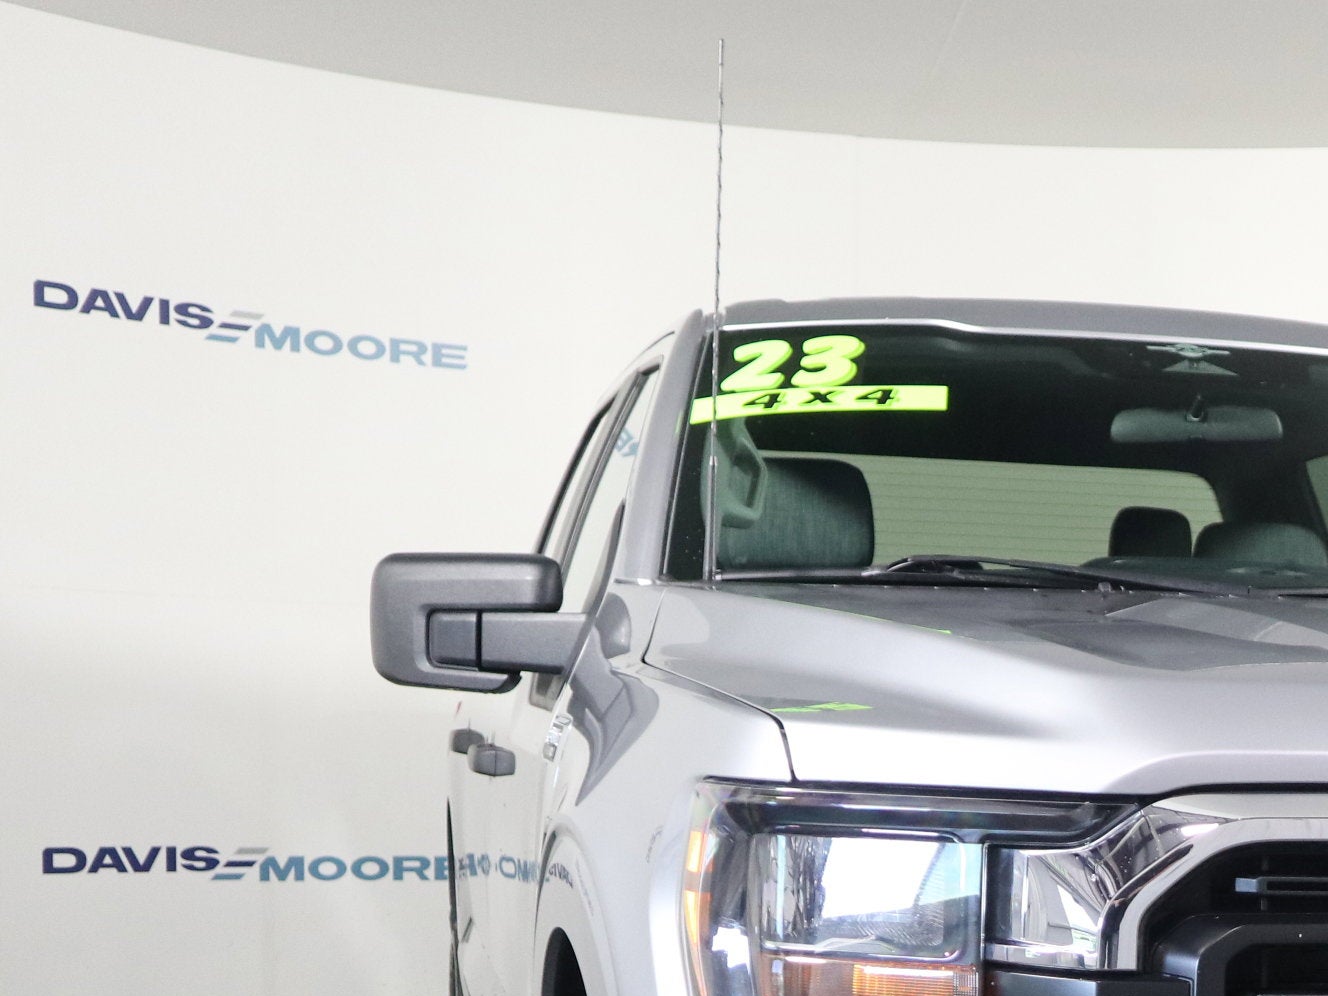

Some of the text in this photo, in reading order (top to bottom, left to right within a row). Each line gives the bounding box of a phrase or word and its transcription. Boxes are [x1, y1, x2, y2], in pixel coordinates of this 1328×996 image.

[32, 278, 468, 370] DAVIS MOORE
[720, 335, 867, 392] 23
[42, 846, 221, 875] DAVIS
